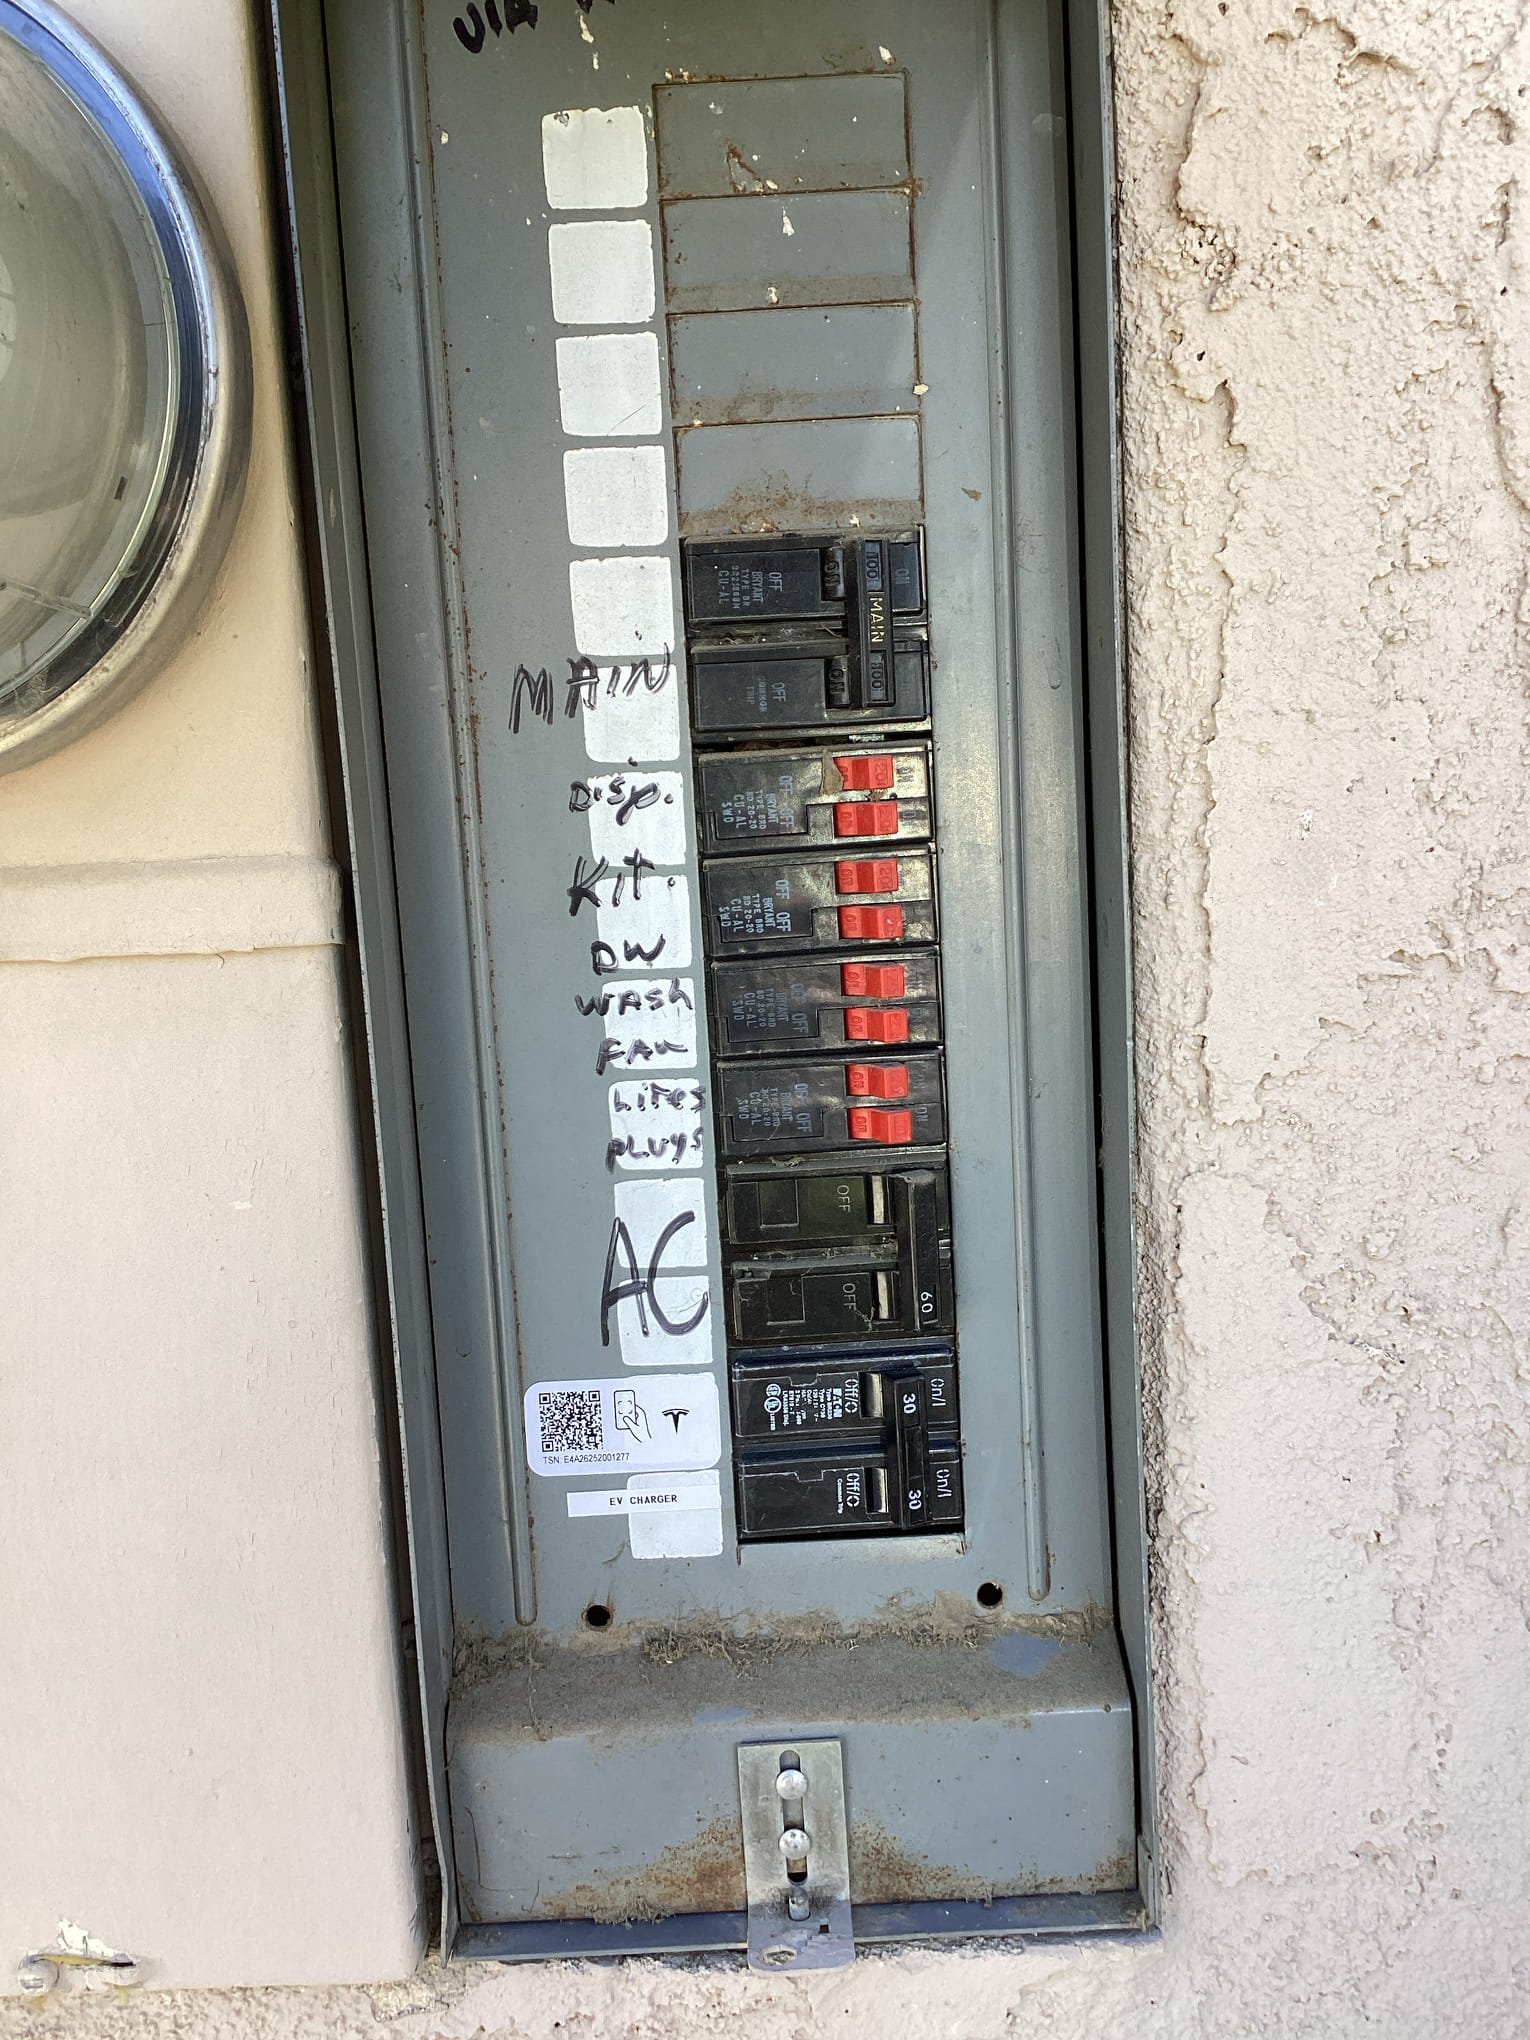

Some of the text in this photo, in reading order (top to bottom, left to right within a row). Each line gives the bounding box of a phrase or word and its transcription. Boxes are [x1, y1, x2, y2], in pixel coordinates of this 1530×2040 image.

[742, 568, 750, 590] TYPE
[751, 571, 763, 602] BRYANT
[768, 572, 783, 592] OFF
[870, 597, 884, 642] MAIN
[508, 643, 671, 734] MAIN
[771, 682, 786, 703] OFF
[722, 801, 734, 823] SWD
[733, 794, 747, 829] CU-AL
[755, 789, 765, 810] TYPE
[766, 793, 779, 824] BRYANT
[779, 775, 795, 828] OFF OFF
[747, 805, 757, 830] 20-20
[719, 906, 731, 927] SWD
[730, 898, 744, 932] CU-AL
[752, 893, 764, 933] TYPE BRD
[762, 897, 776, 927] BRYANT
[776, 879, 792, 932] OFF OFF
[744, 909, 755, 933] 20-20
[590, 933, 667, 976] DW
[732, 1000, 744, 1020] SWD
[744, 992, 757, 1026] CU-AL
[776, 992, 789, 1021] BRYANT
[792, 1013, 808, 1033] OFF
[737, 1099, 749, 1119] SWD
[750, 1091, 762, 1125] CU-AL
[780, 1092, 793, 1121] BRYANT
[915, 1106, 928, 1122] ON
[796, 1112, 812, 1132] OFF
[836, 1184, 851, 1213] OFF
[601, 1210, 710, 1346] AC
[842, 1283, 856, 1310] OFF
[920, 1291, 933, 1313] 60
[902, 1393, 917, 1414] 30
[563, 1452, 630, 1464] E4A26252001277
[609, 1494, 678, 1506] EV CHARGER
[908, 1489, 922, 1510] 30
